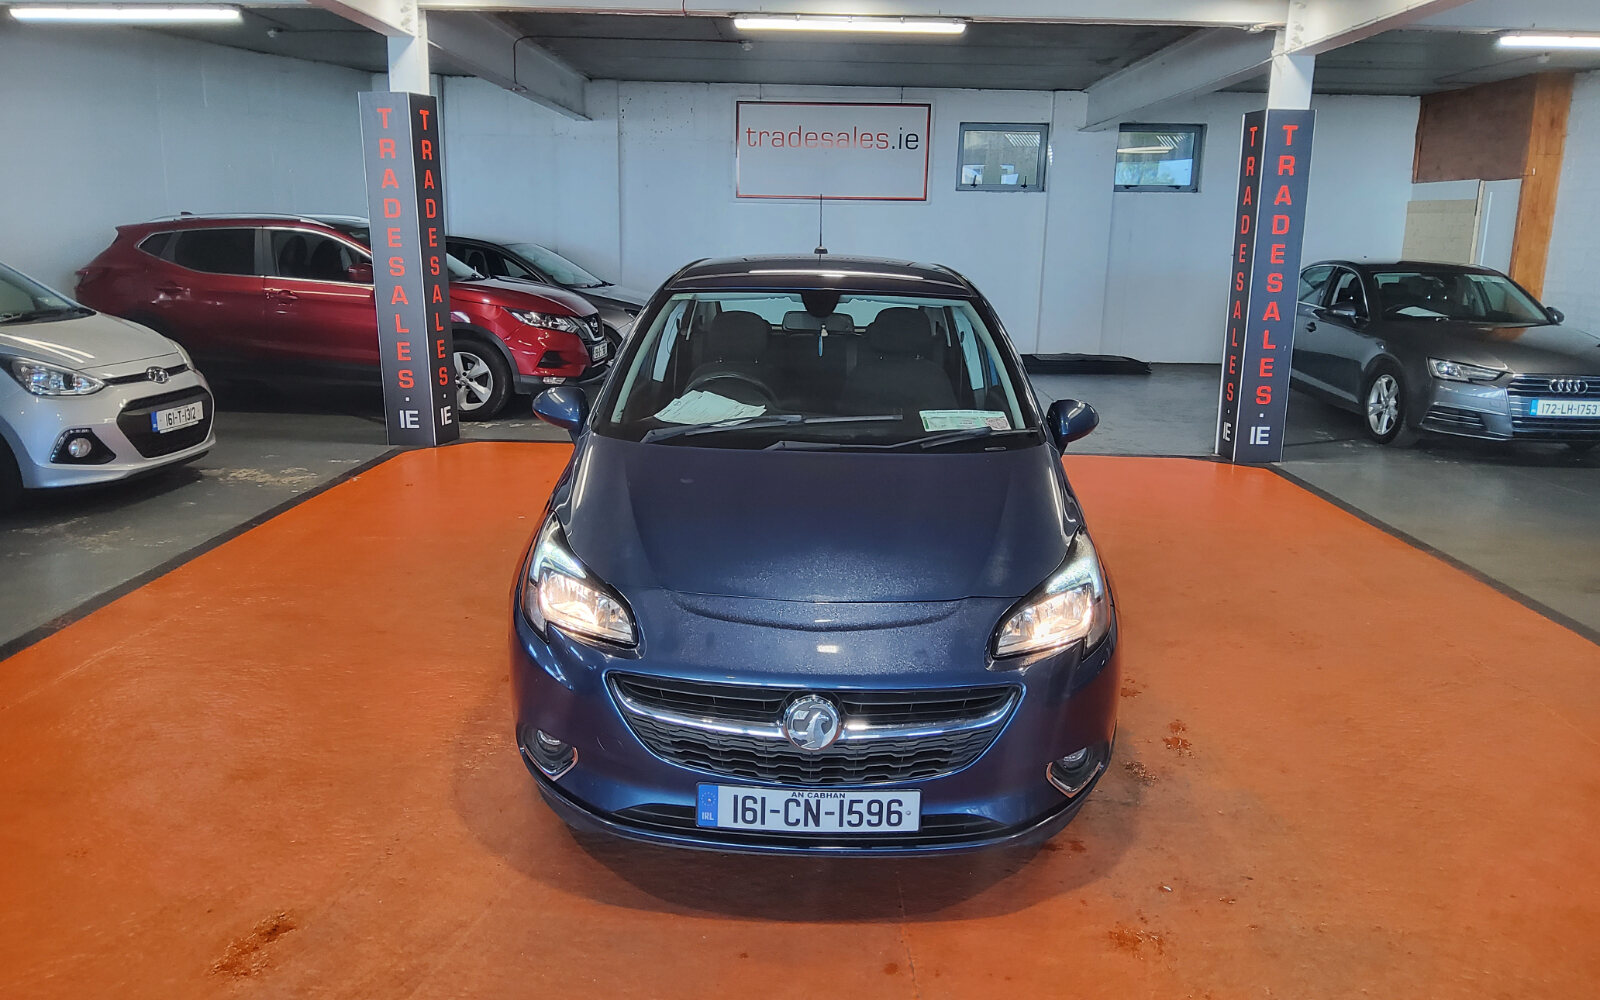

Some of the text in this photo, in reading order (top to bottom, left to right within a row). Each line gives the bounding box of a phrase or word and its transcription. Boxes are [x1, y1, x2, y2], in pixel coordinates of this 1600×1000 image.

[745, 125, 919, 150] tradesales.ie
[1541, 403, 1598, 415] 172-LH-1753
[701, 811, 714, 821] IRL
[733, 794, 904, 828] 161-CN-1596
